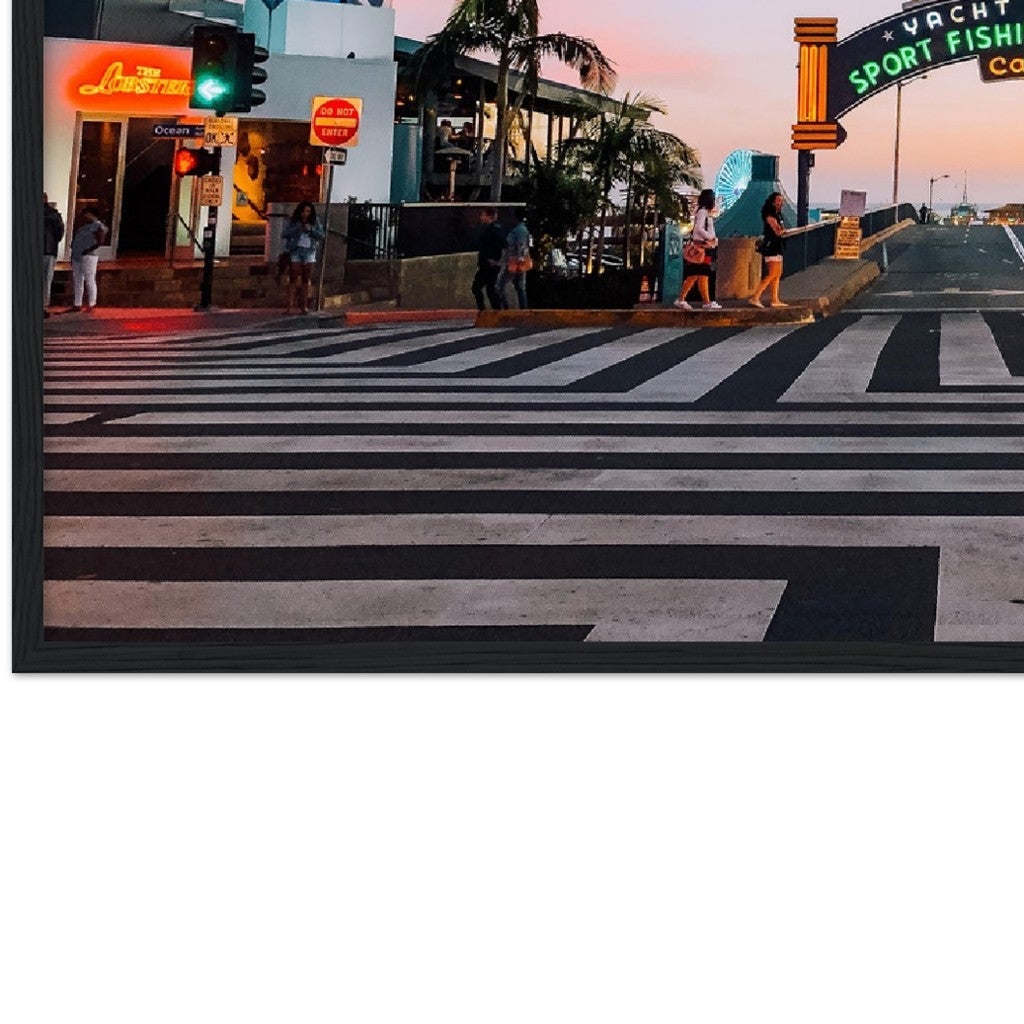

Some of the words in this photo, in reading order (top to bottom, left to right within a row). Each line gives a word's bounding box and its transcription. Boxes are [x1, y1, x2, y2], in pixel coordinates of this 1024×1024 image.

[848, 37, 932, 95] SPORT
[136, 65, 161, 78] THE
[321, 107, 333, 116] DO
[336, 107, 355, 116] NOT
[154, 125, 190, 135] Ocean
[321, 127, 349, 137] ENTER
